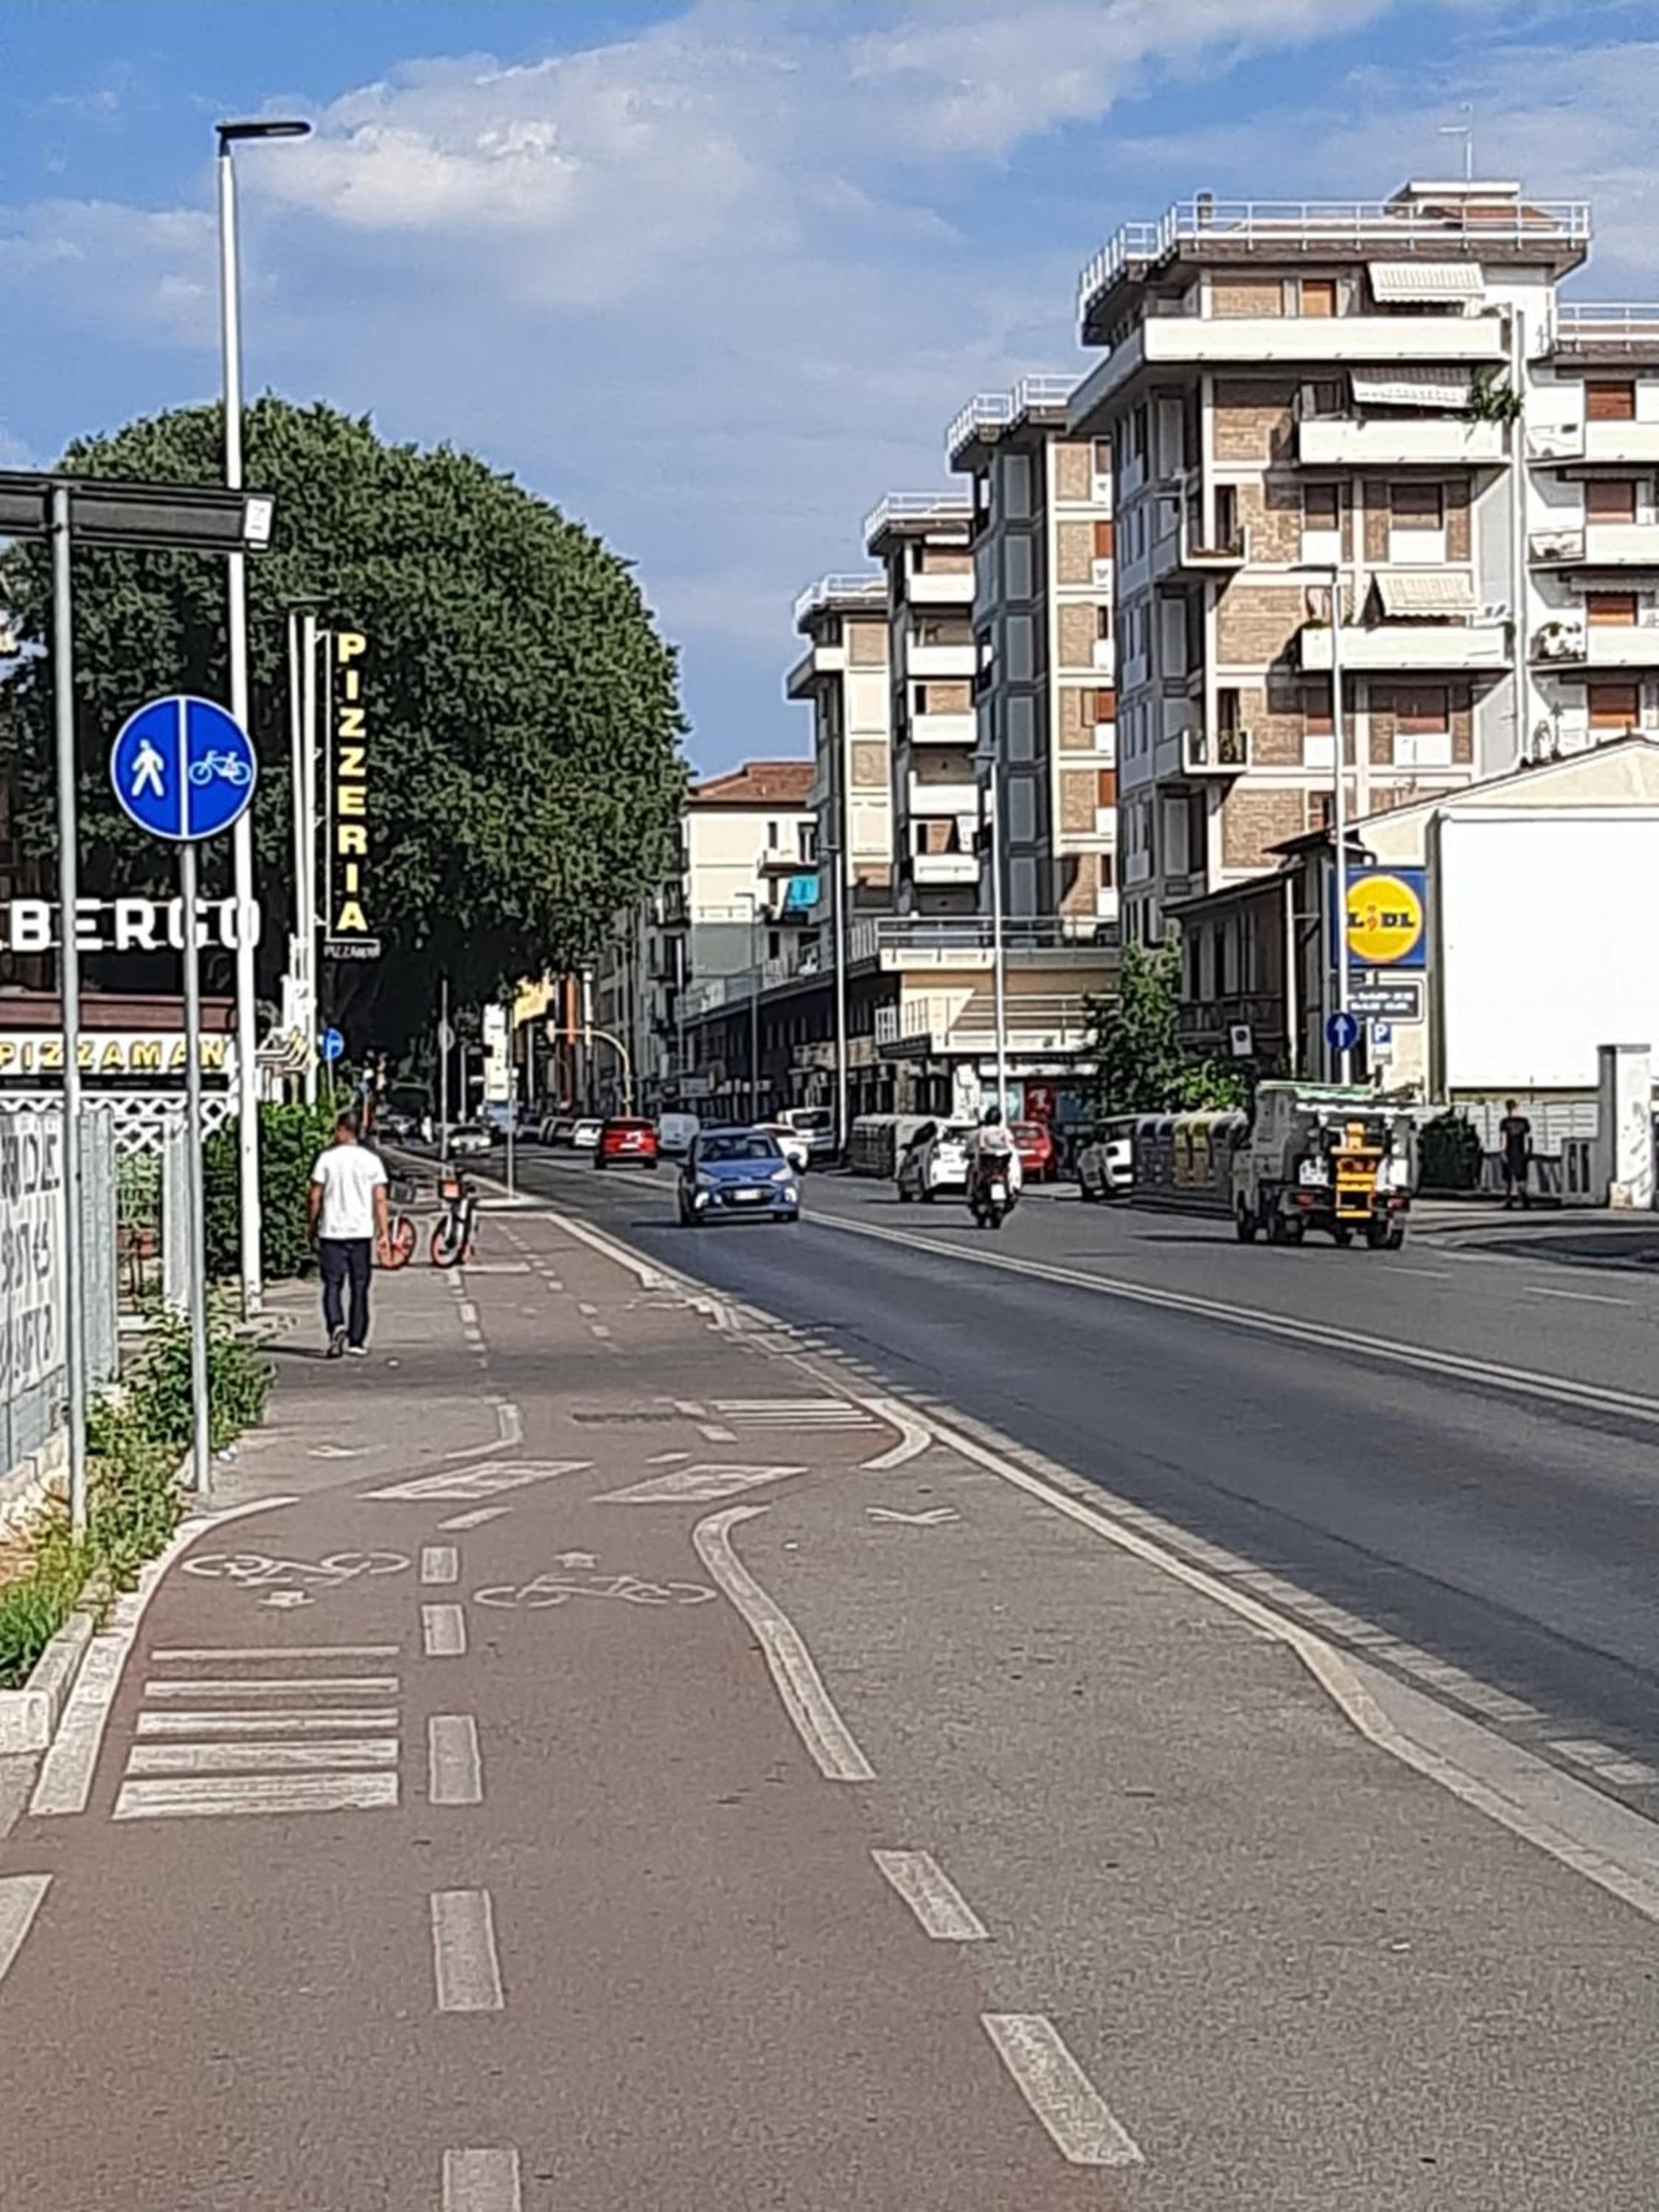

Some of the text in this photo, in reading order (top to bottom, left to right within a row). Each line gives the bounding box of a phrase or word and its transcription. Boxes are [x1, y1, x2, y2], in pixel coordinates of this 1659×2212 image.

[336, 632, 368, 931] PIZZERIA
[0, 897, 260, 951] BERGO
[1374, 1023, 1388, 1041] P
[0, 1040, 223, 1069] PIZZAMAN
